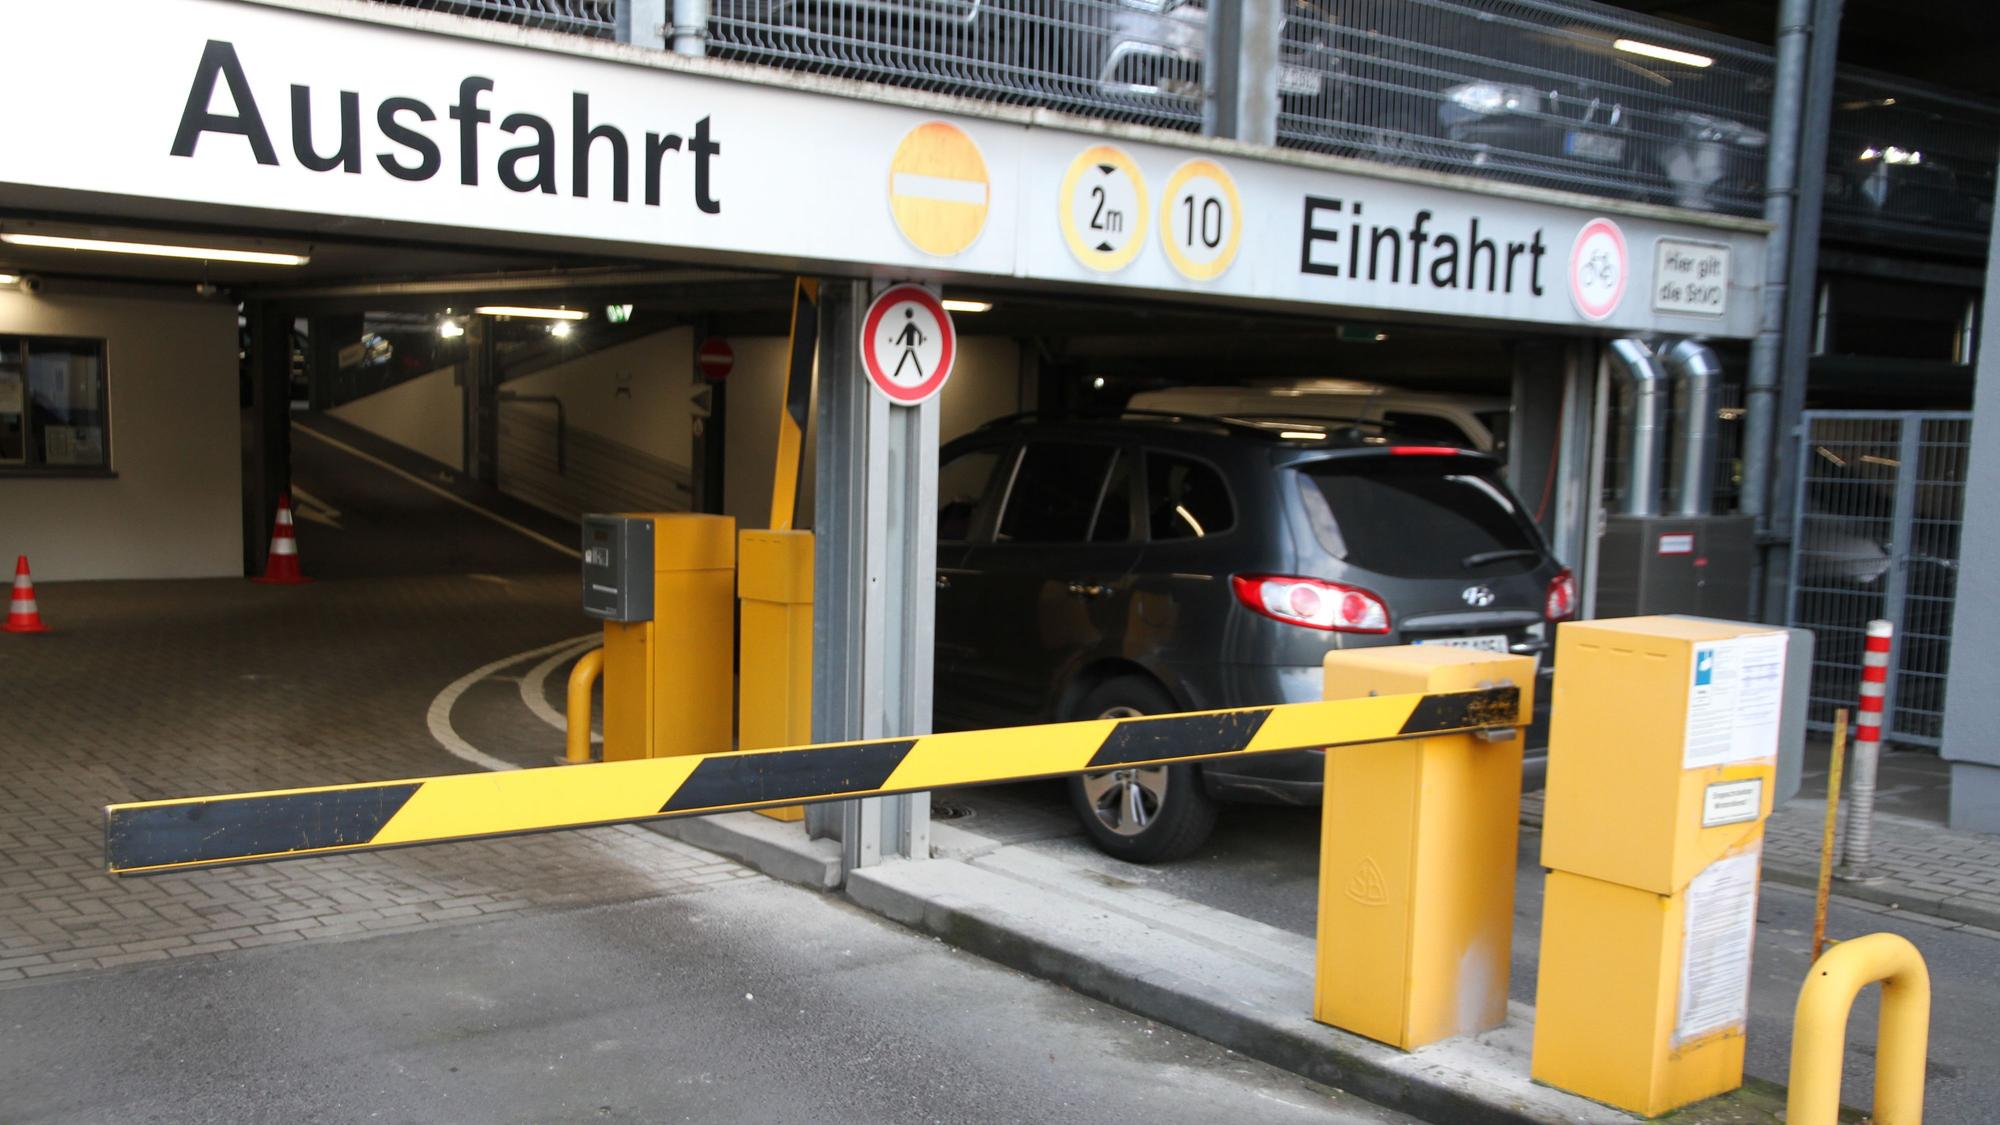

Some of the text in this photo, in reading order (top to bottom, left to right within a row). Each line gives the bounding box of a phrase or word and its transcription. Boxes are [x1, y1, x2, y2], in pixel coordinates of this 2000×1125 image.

[170, 39, 722, 215] Ausfahrt
[1184, 195, 1223, 249] 10
[1300, 194, 1548, 297] Einfahrt
[1664, 250, 1721, 280] Hier gilt
[1659, 282, 1682, 303] die
